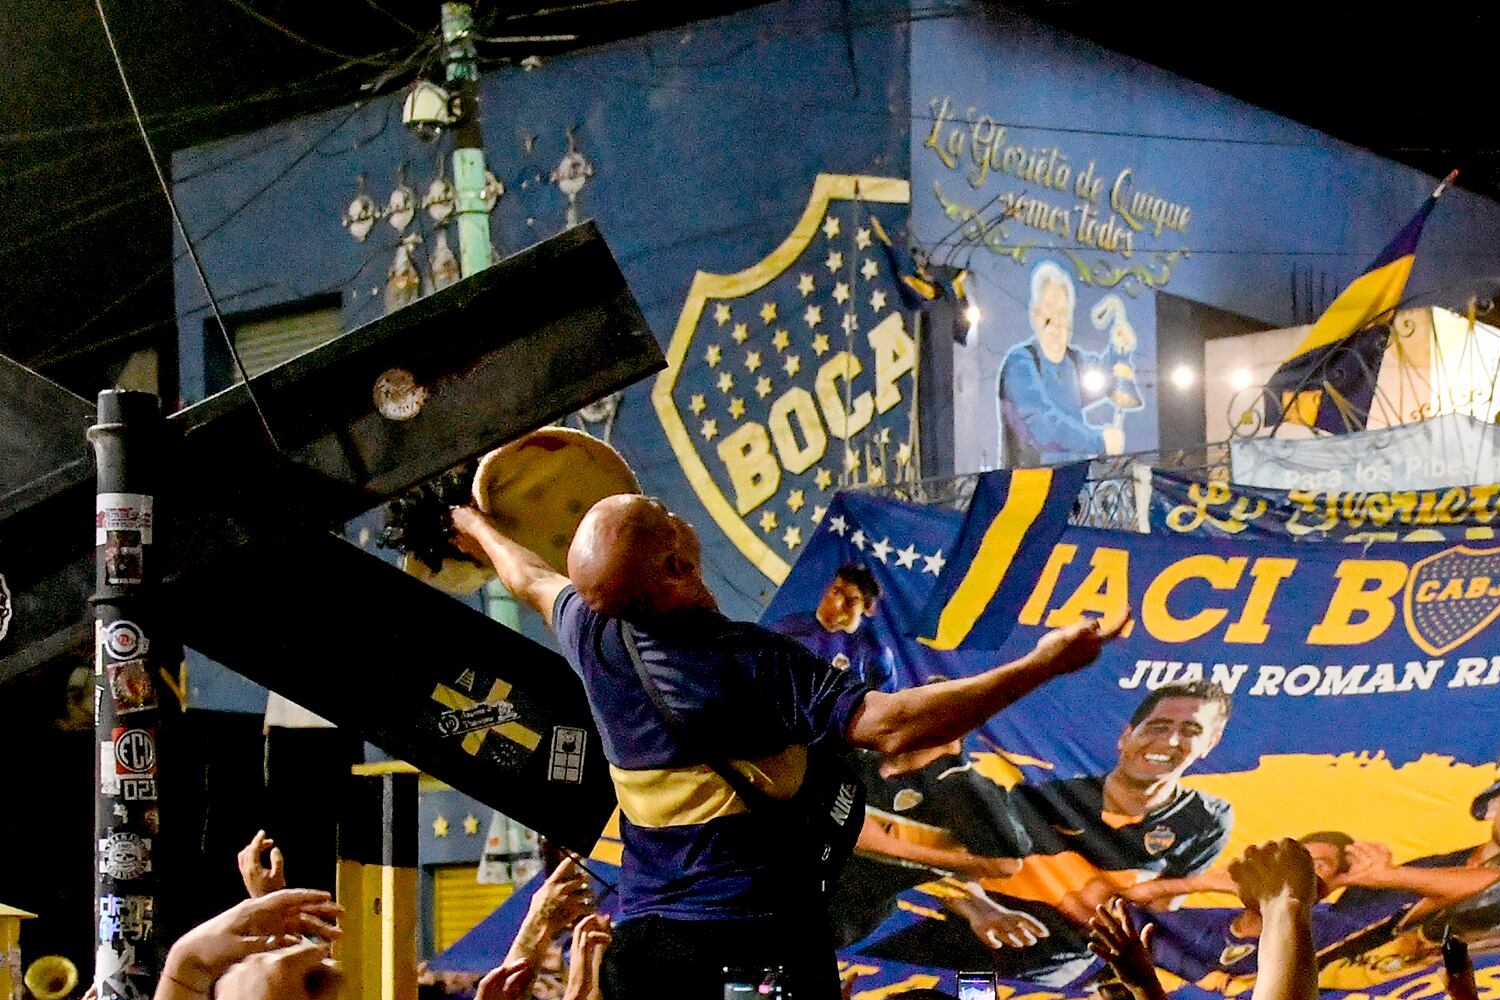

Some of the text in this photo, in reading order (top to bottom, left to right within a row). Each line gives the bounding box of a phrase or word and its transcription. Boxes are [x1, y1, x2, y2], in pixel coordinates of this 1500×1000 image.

[924, 96, 966, 169] La
[967, 113, 1073, 191] Glorieta
[1074, 159, 1104, 202] de
[1001, 191, 1133, 258] somos todos
[716, 311, 917, 518] BOCA
[1355, 461, 1393, 485] los
[1118, 659, 1248, 696] JUAN
[1248, 659, 1444, 697] ROMAN
